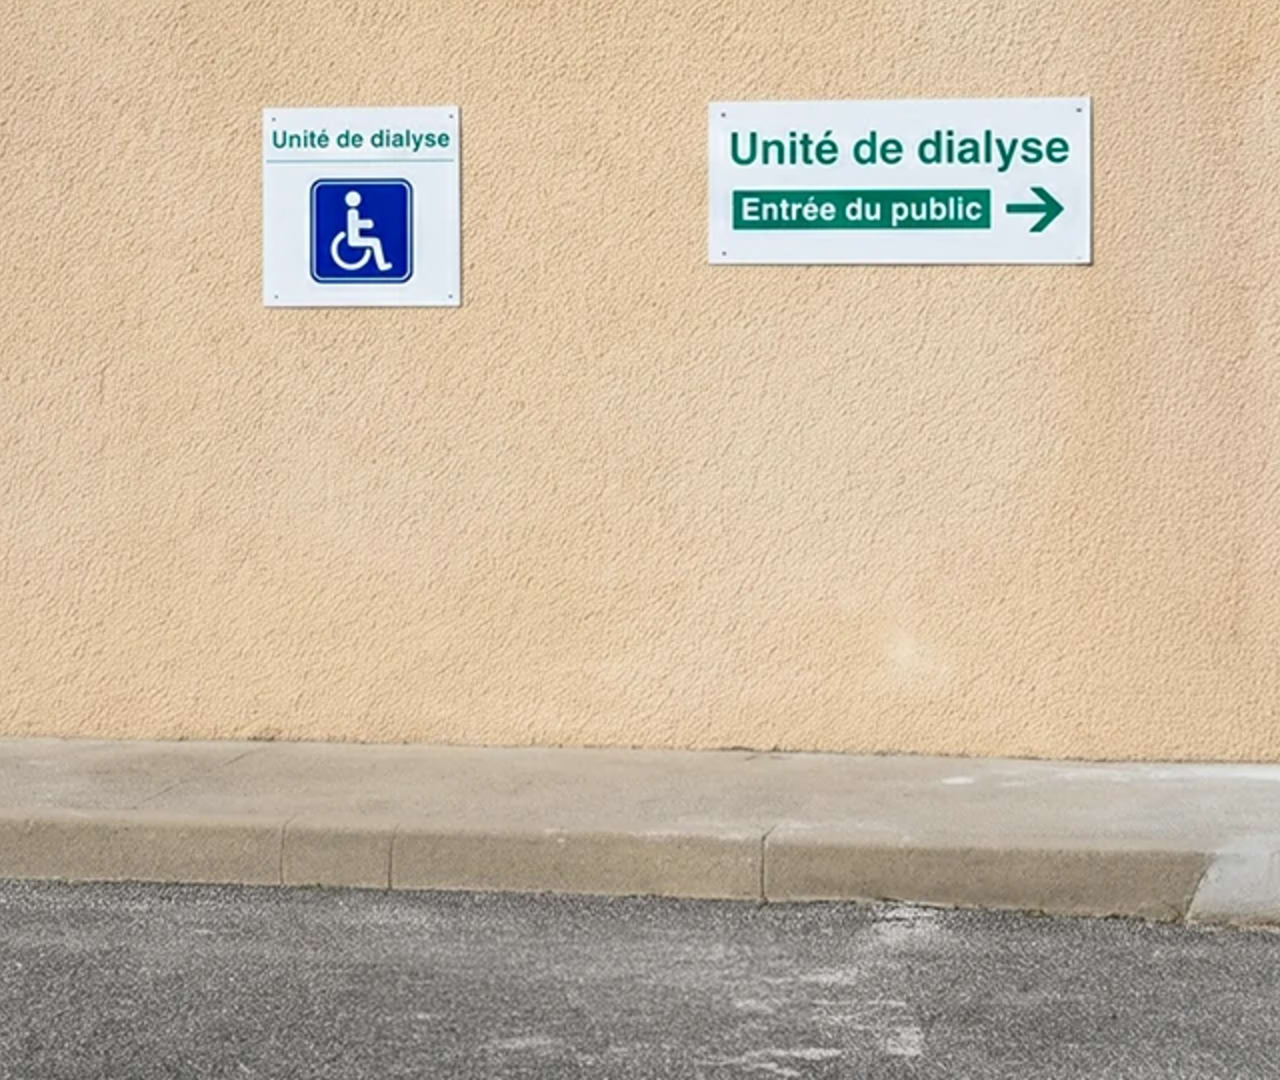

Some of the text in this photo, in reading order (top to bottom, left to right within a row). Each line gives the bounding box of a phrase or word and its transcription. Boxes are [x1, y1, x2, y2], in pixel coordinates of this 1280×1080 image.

[272, 128, 450, 152] Unité de dialyse
[730, 129, 1070, 173] Unité de dialyse
[741, 196, 983, 227] Entrée du public
